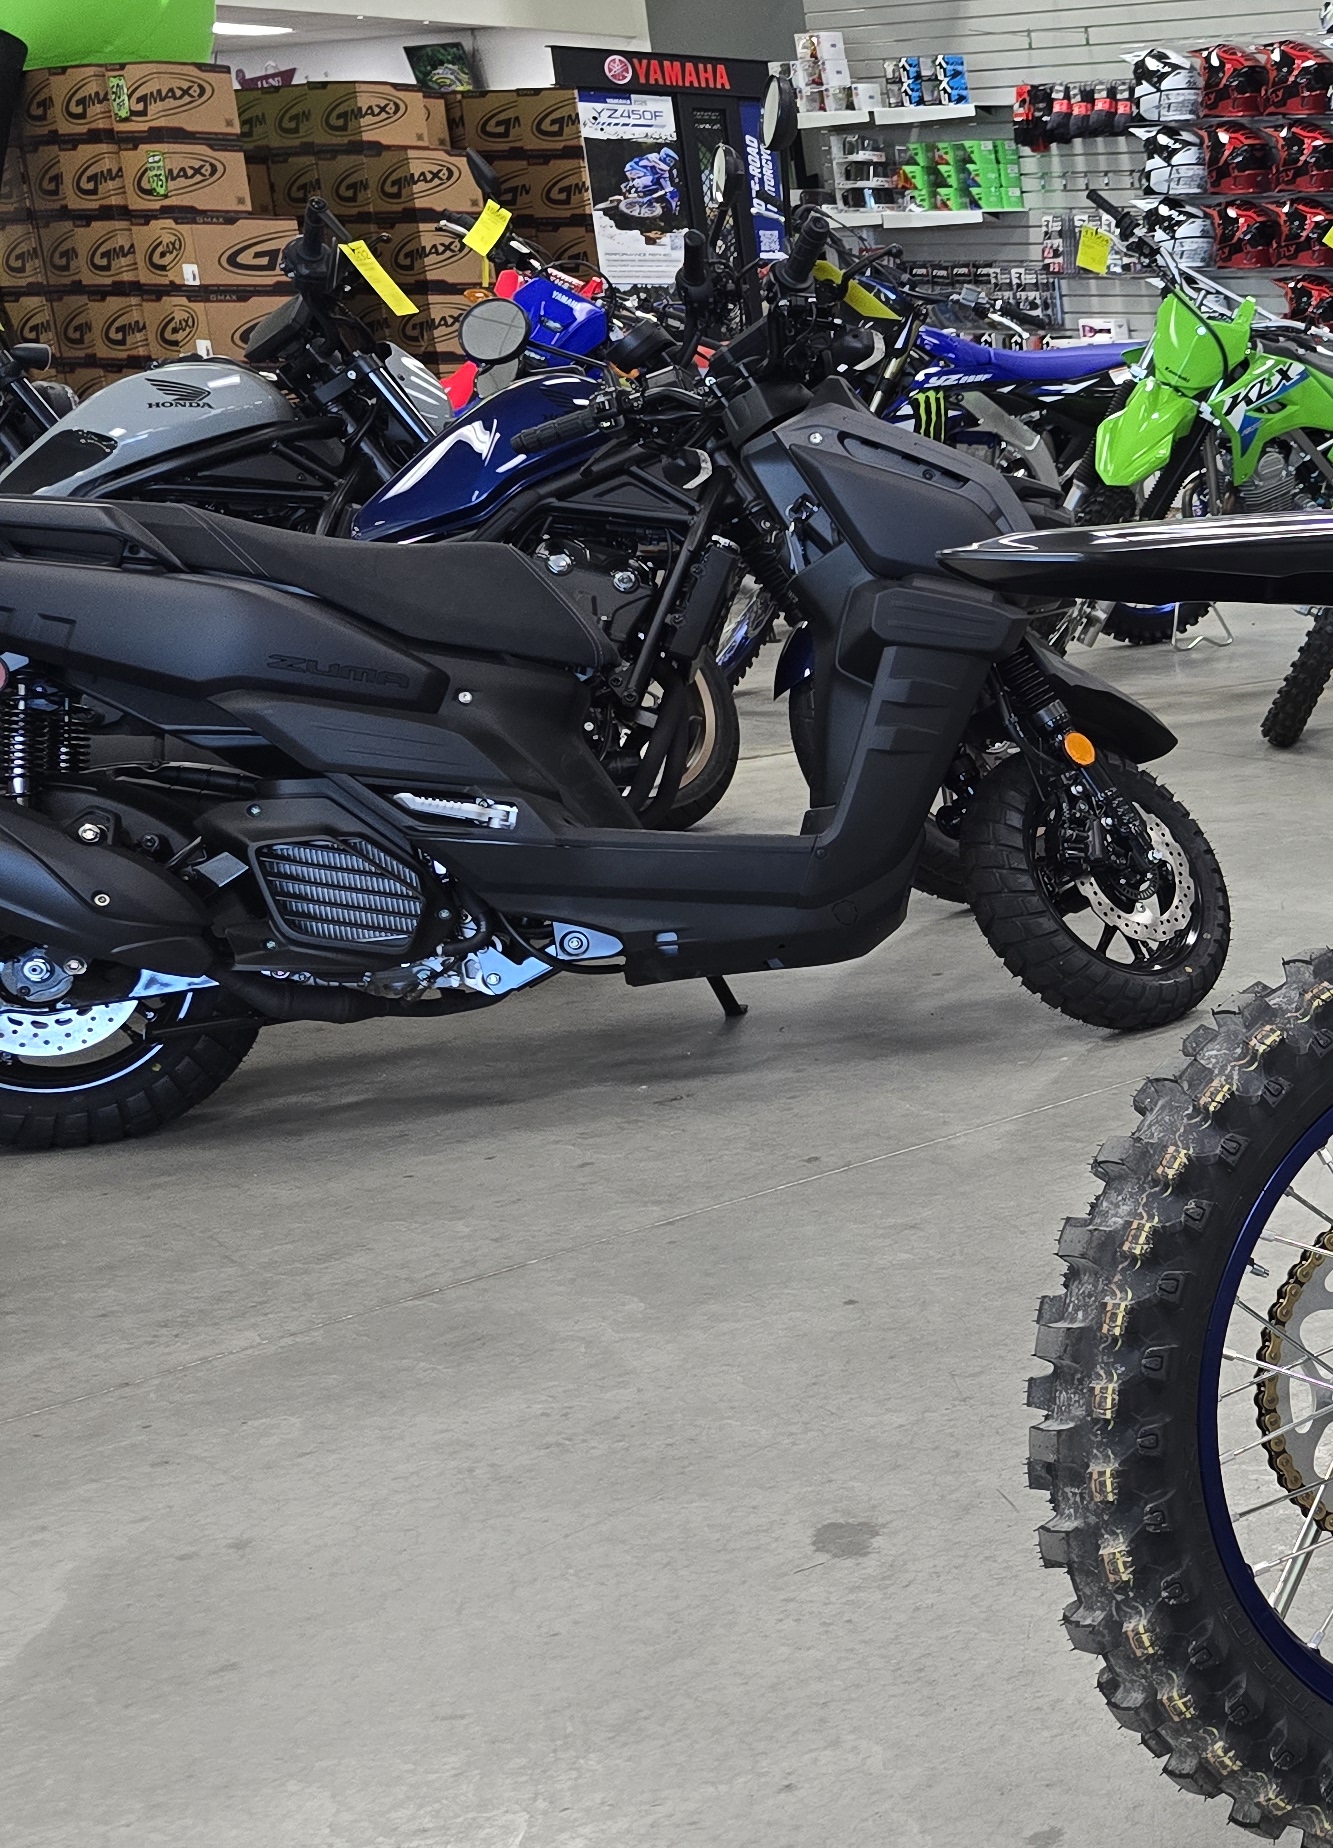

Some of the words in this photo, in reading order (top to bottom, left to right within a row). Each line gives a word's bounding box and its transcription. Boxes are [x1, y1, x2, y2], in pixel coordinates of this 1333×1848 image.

[632, 58, 731, 90] YAMAHA
[325, 96, 400, 134] GMAX
[592, 107, 664, 120] YZ450F
[380, 161, 453, 200] GMAX
[1222, 362, 1294, 417] KLX
[267, 654, 410, 689] ZUMA
